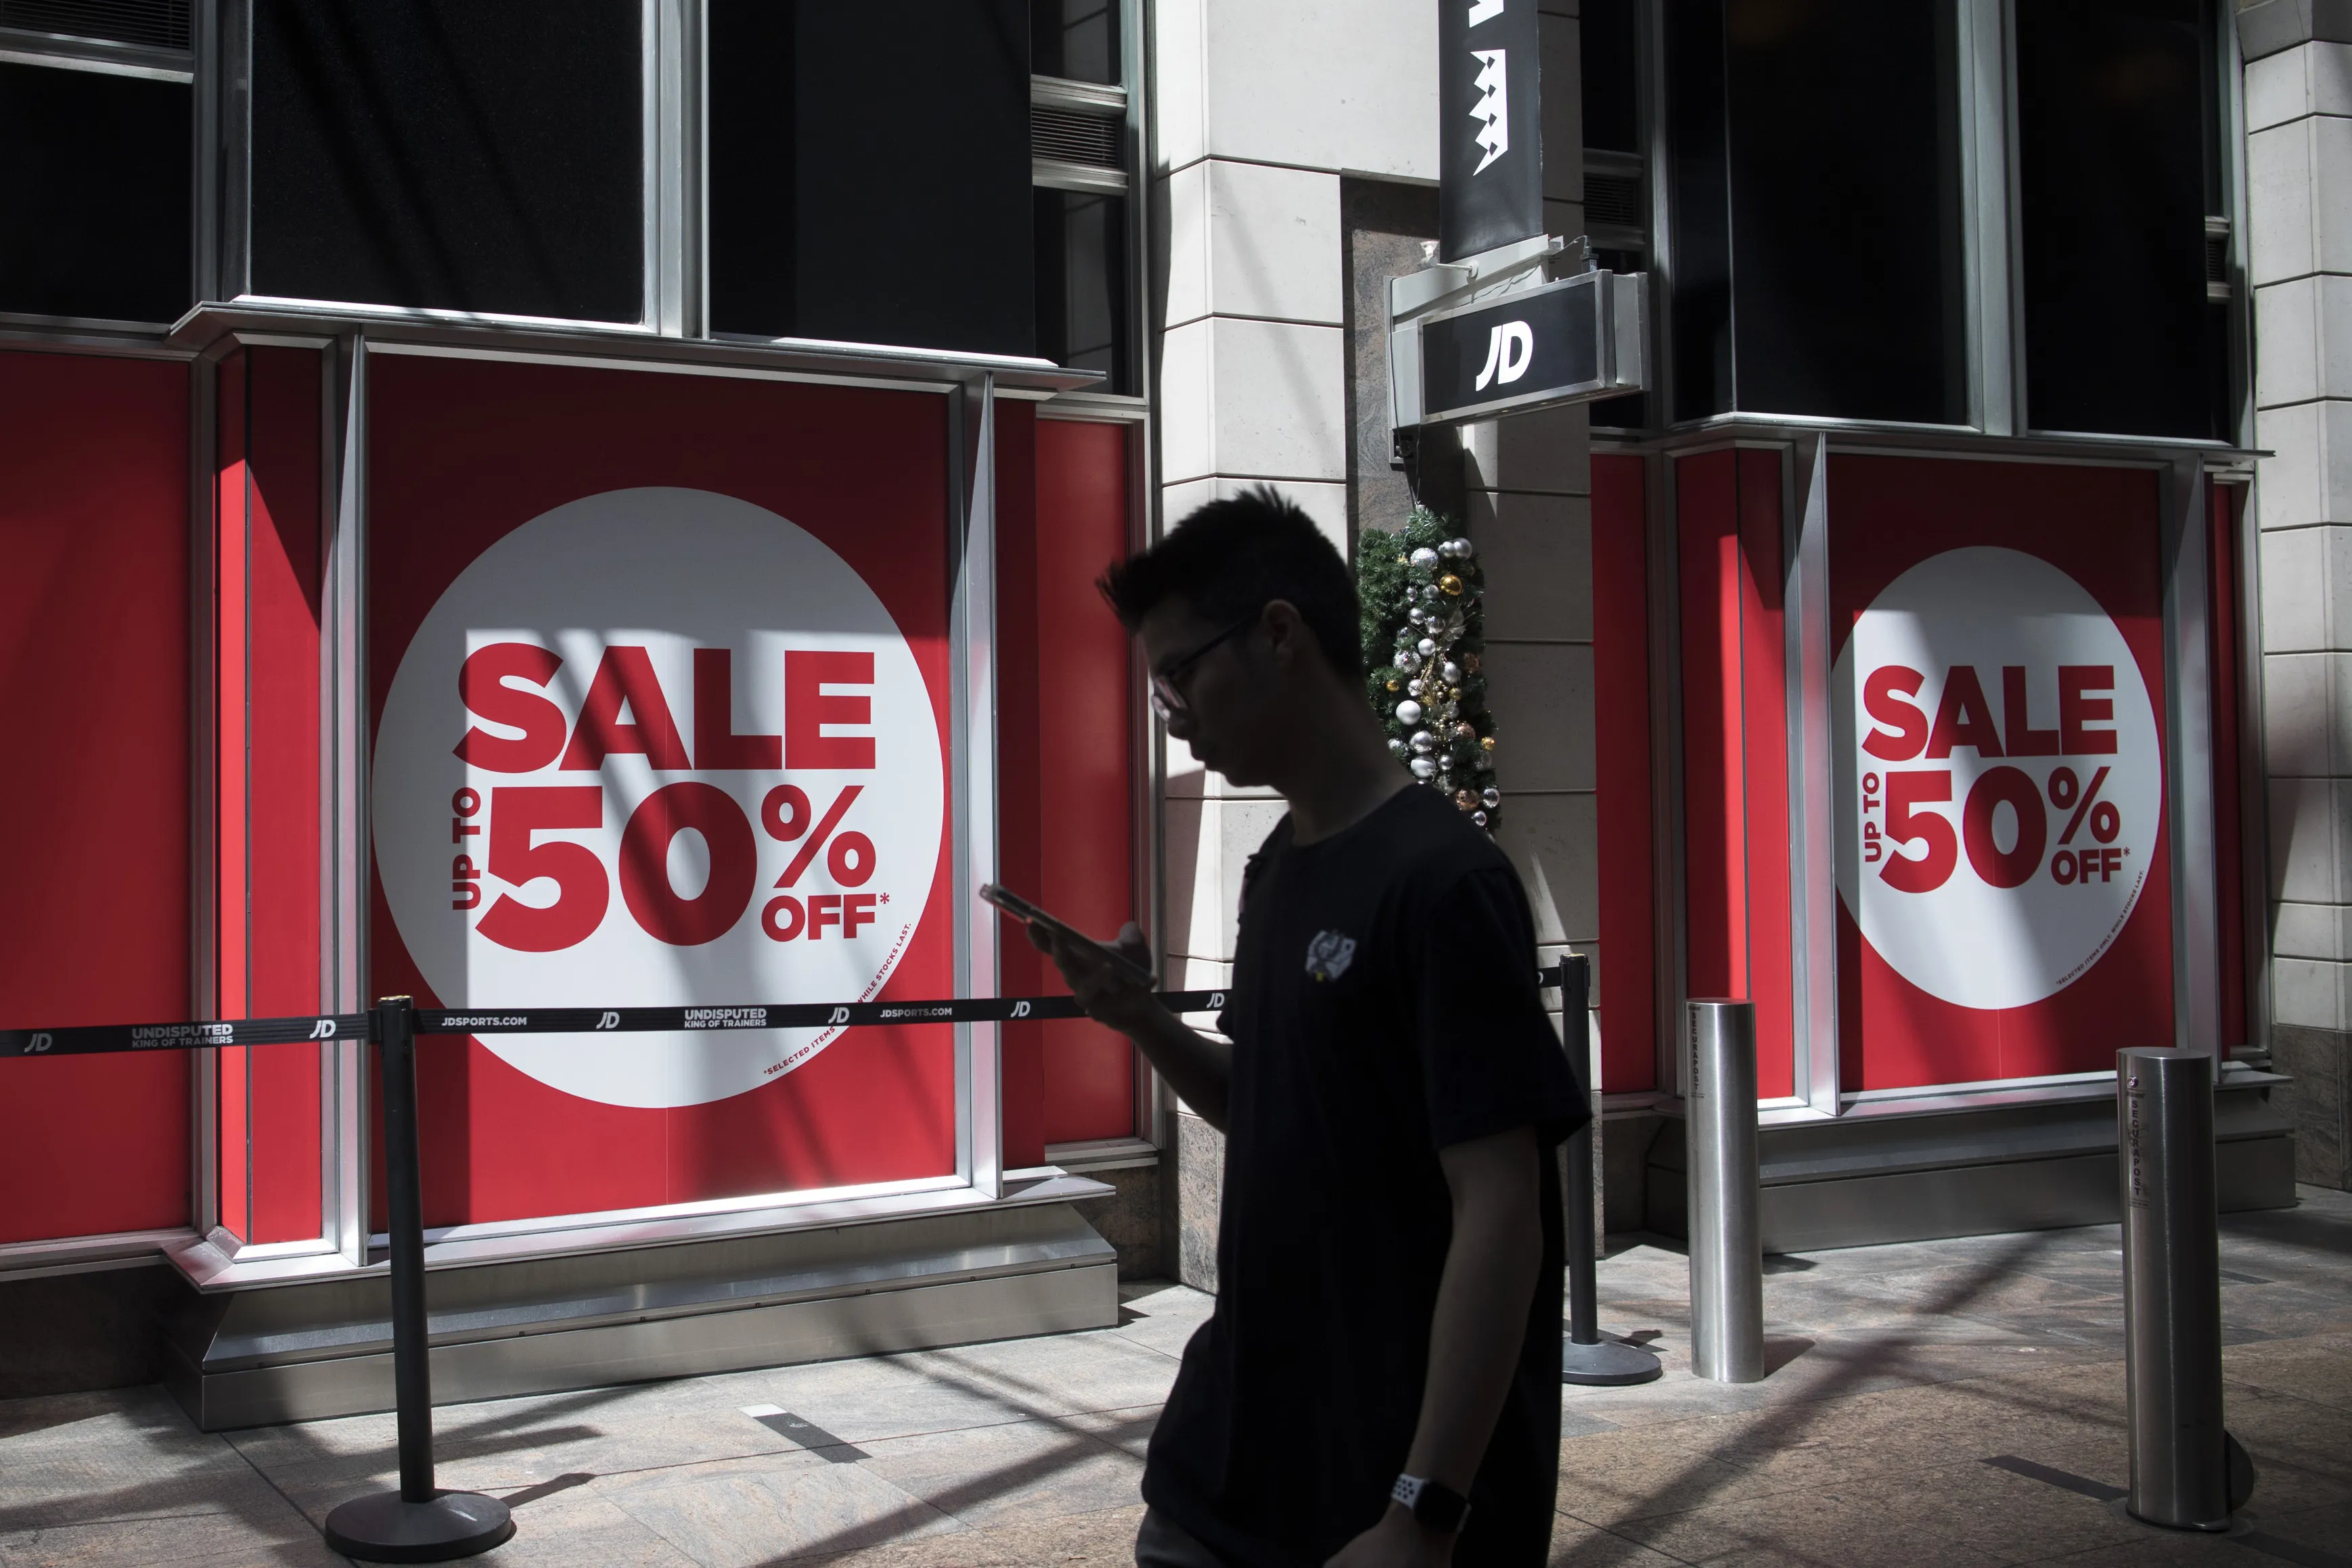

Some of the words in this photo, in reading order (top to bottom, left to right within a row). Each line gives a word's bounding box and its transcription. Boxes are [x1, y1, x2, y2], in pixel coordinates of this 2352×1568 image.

[1476, 321, 1533, 392] JD
[452, 642, 876, 773] SALE
[1861, 664, 2118, 762] SALE
[1862, 772, 1880, 814] TO
[453, 787, 481, 844] TO
[1878, 766, 2121, 894] 50%
[1863, 821, 1882, 862] UP
[452, 854, 481, 910] UP
[475, 781, 877, 952] 50%
[2085, 948, 2100, 965] ITEMS
[2111, 913, 2125, 933] WHILE
[2123, 888, 2137, 914] STOCKS
[811, 1025, 836, 1048] ITEMS
[876, 948, 899, 981] STOCKS
[896, 923, 911, 946] LAST.
[1206, 992, 1225, 1009] JD
[442, 1017, 527, 1026] JDSPORTS.COM
[595, 1011, 620, 1030] JD
[684, 1008, 767, 1020] UNDISPUTED
[723, 1019, 767, 1027] TRAINERS
[828, 1007, 850, 1024] JD
[880, 1007, 952, 1018] JDSPORTS.COM
[1010, 1001, 1031, 1018] JD
[24, 1032, 53, 1053] JD
[132, 1023, 233, 1039] UNDISPUTED
[132, 1039, 158, 1048] KING
[161, 1038, 177, 1046] OF
[179, 1036, 233, 1046] TRAINERS
[309, 1019, 336, 1039] JD
[2132, 1100, 2142, 1195] SECURAPOST
